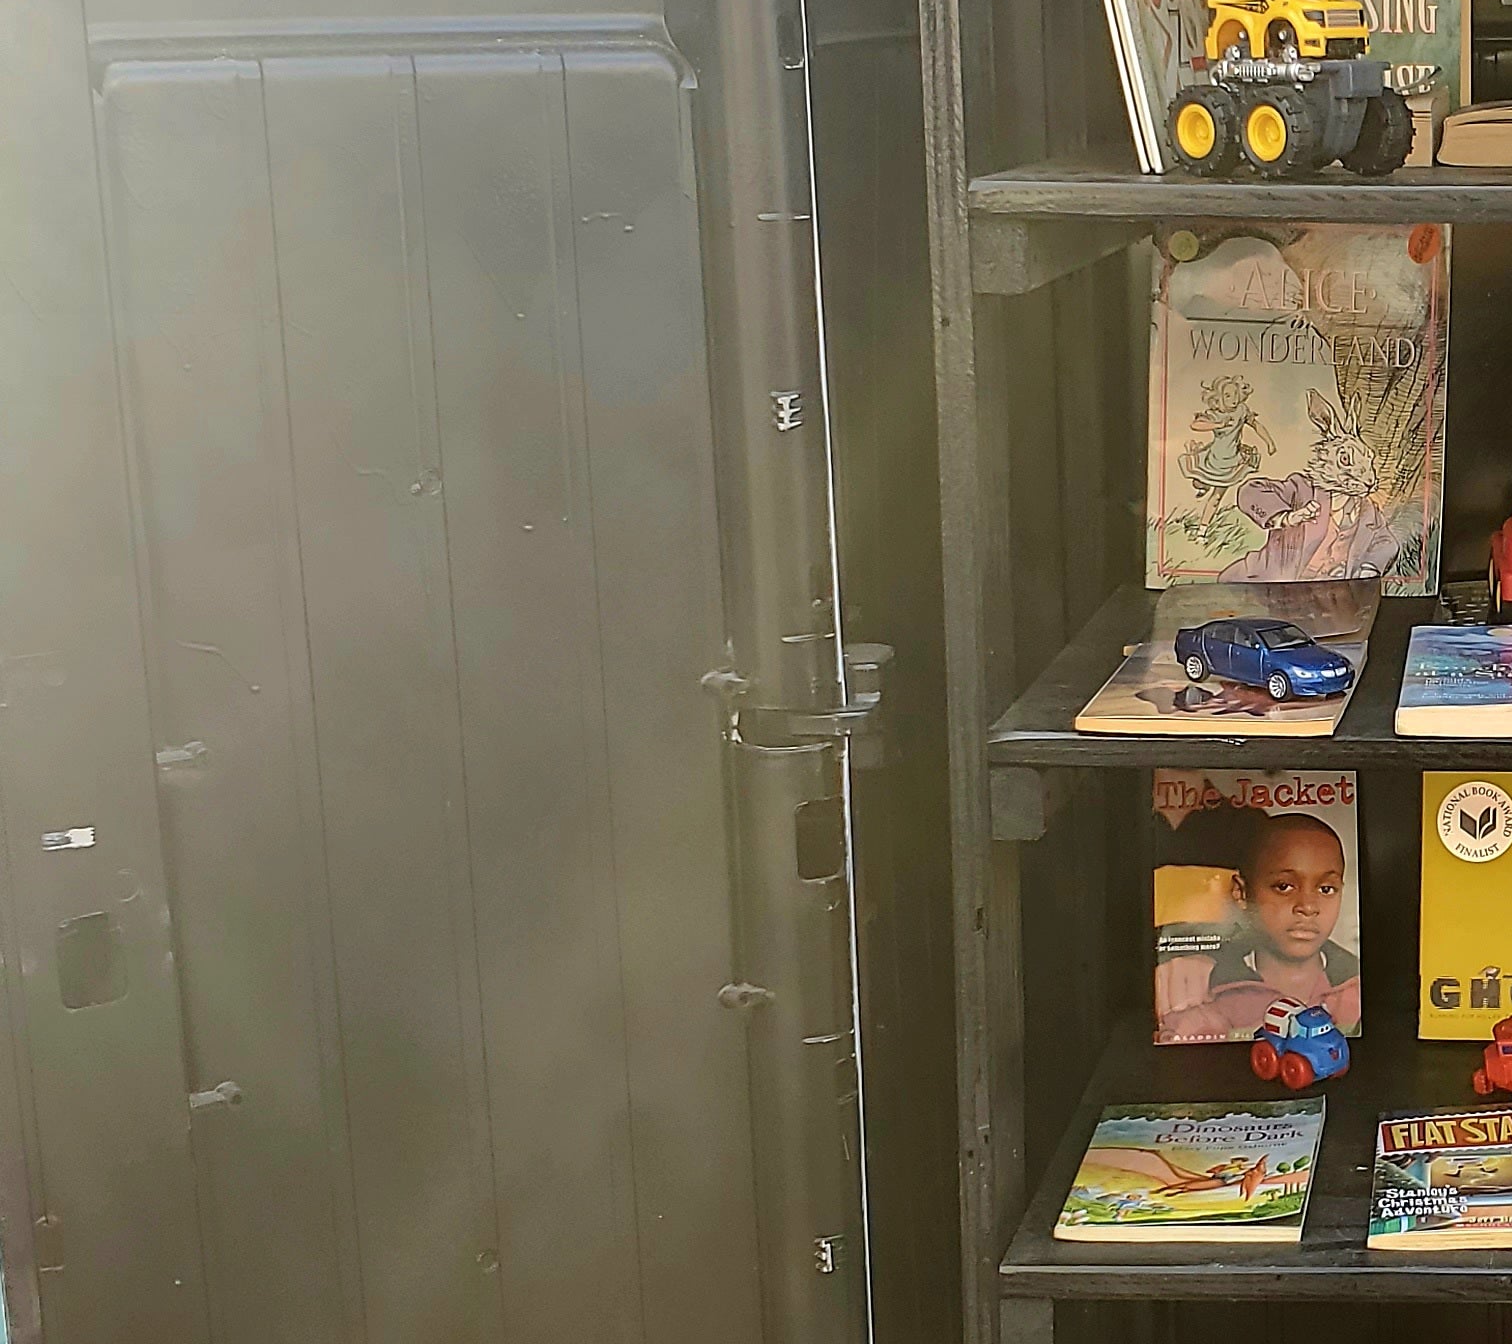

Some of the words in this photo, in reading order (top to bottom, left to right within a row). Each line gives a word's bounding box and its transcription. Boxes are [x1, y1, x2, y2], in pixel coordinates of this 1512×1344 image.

[1190, 329, 1417, 367] WONDERLAND
[1156, 779, 1221, 812] The
[1229, 775, 1356, 809] Jacket
[1443, 790, 1470, 836] NATIONAL
[1472, 787, 1501, 801] BOOK
[1498, 801, 1512, 837] AWARD
[1455, 843, 1499, 858] FINALIST
[1155, 1134, 1235, 1144] Before
[1245, 1130, 1303, 1142] Dark
[1173, 1123, 1294, 1133] Dinosaurs
[1390, 1121, 1457, 1151] FLAT
[1378, 1195, 1468, 1207] Christmas
